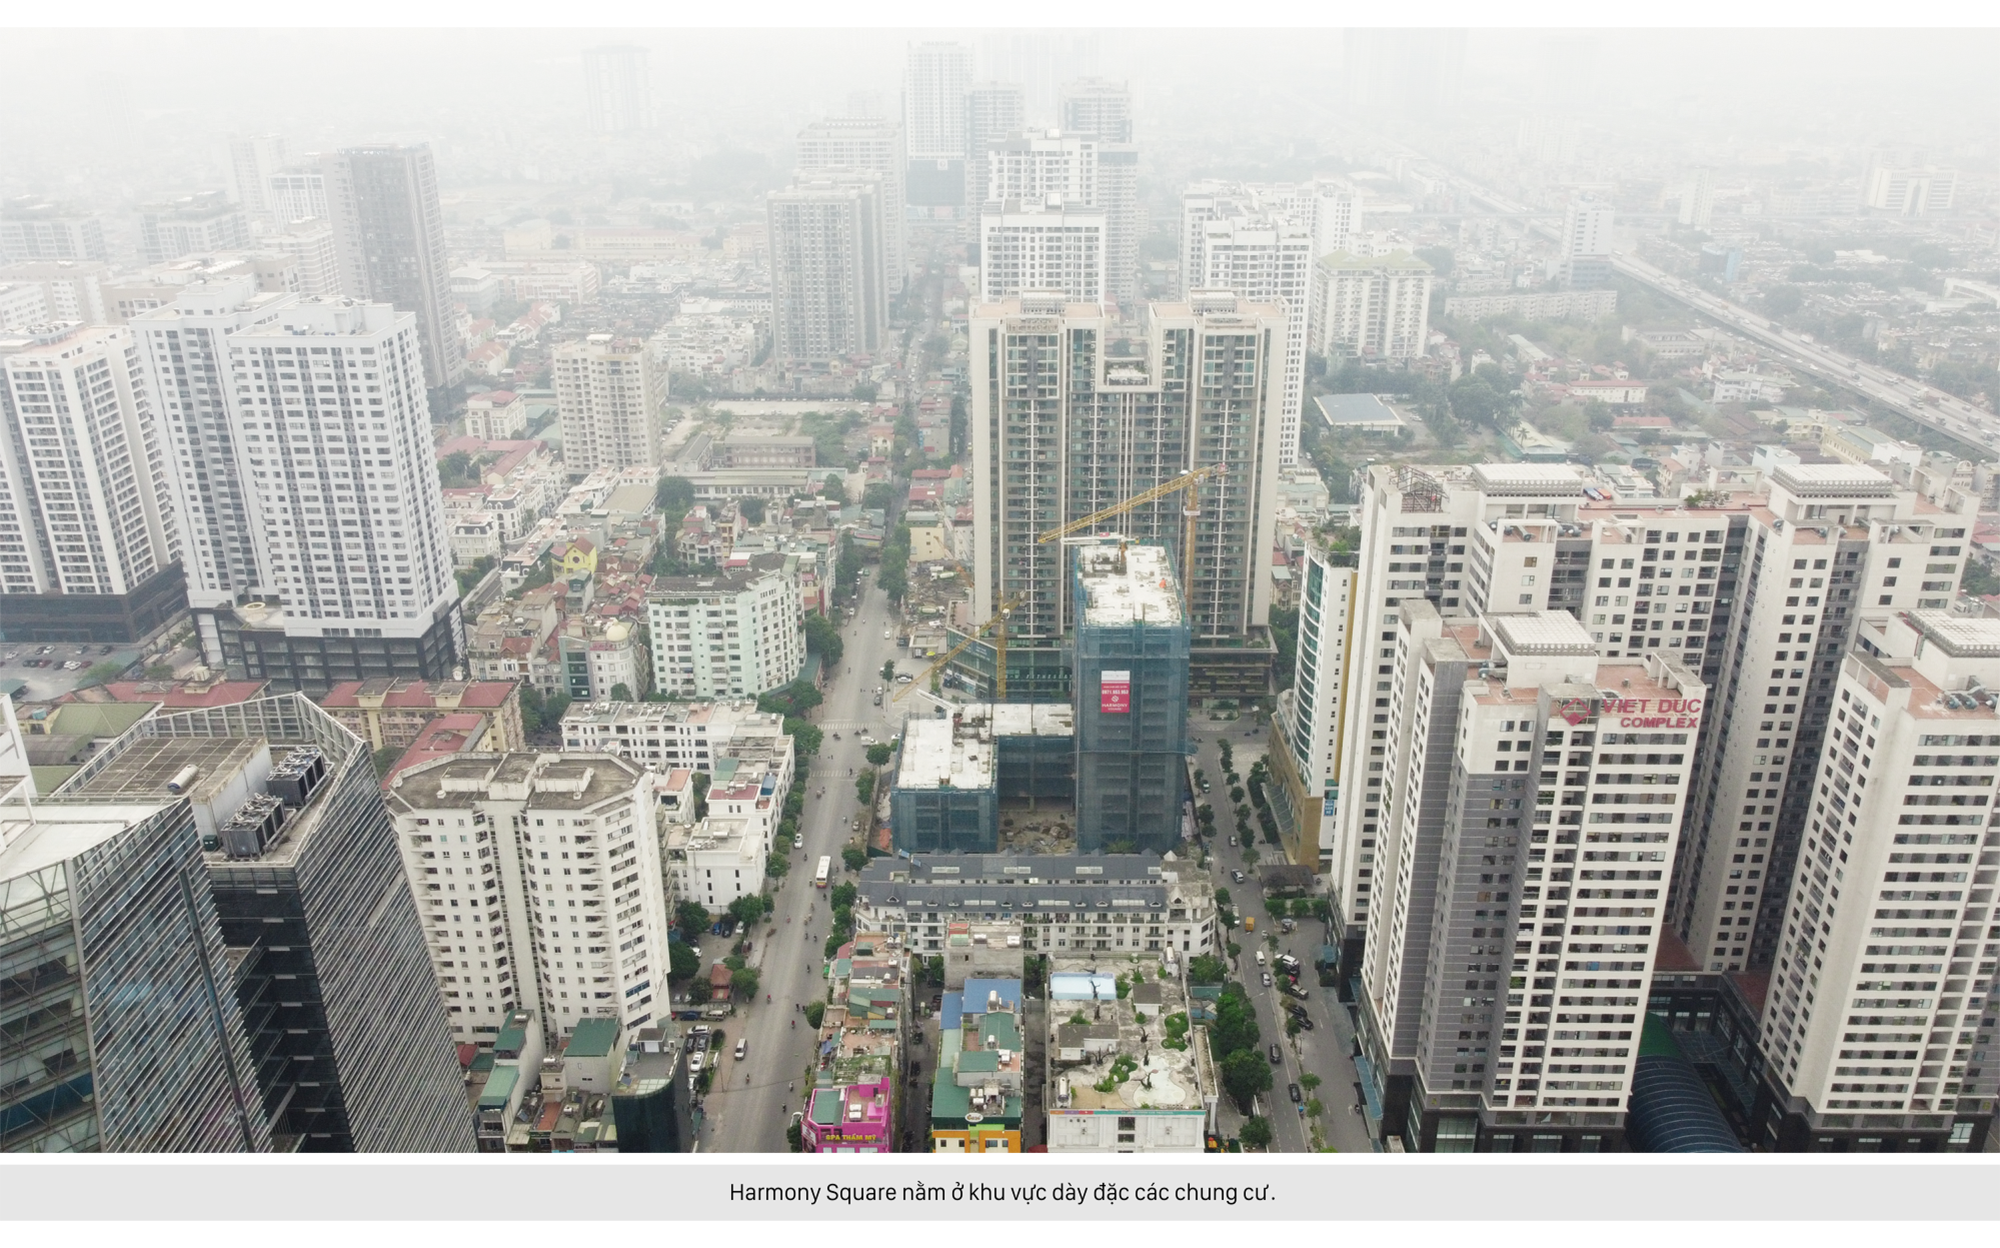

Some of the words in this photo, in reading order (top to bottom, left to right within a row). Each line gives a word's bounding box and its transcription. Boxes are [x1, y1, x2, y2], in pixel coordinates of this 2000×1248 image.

[1603, 698, 1651, 713] VIET
[1658, 698, 1702, 713] DUC
[1621, 717, 1698, 728] COMPLEX
